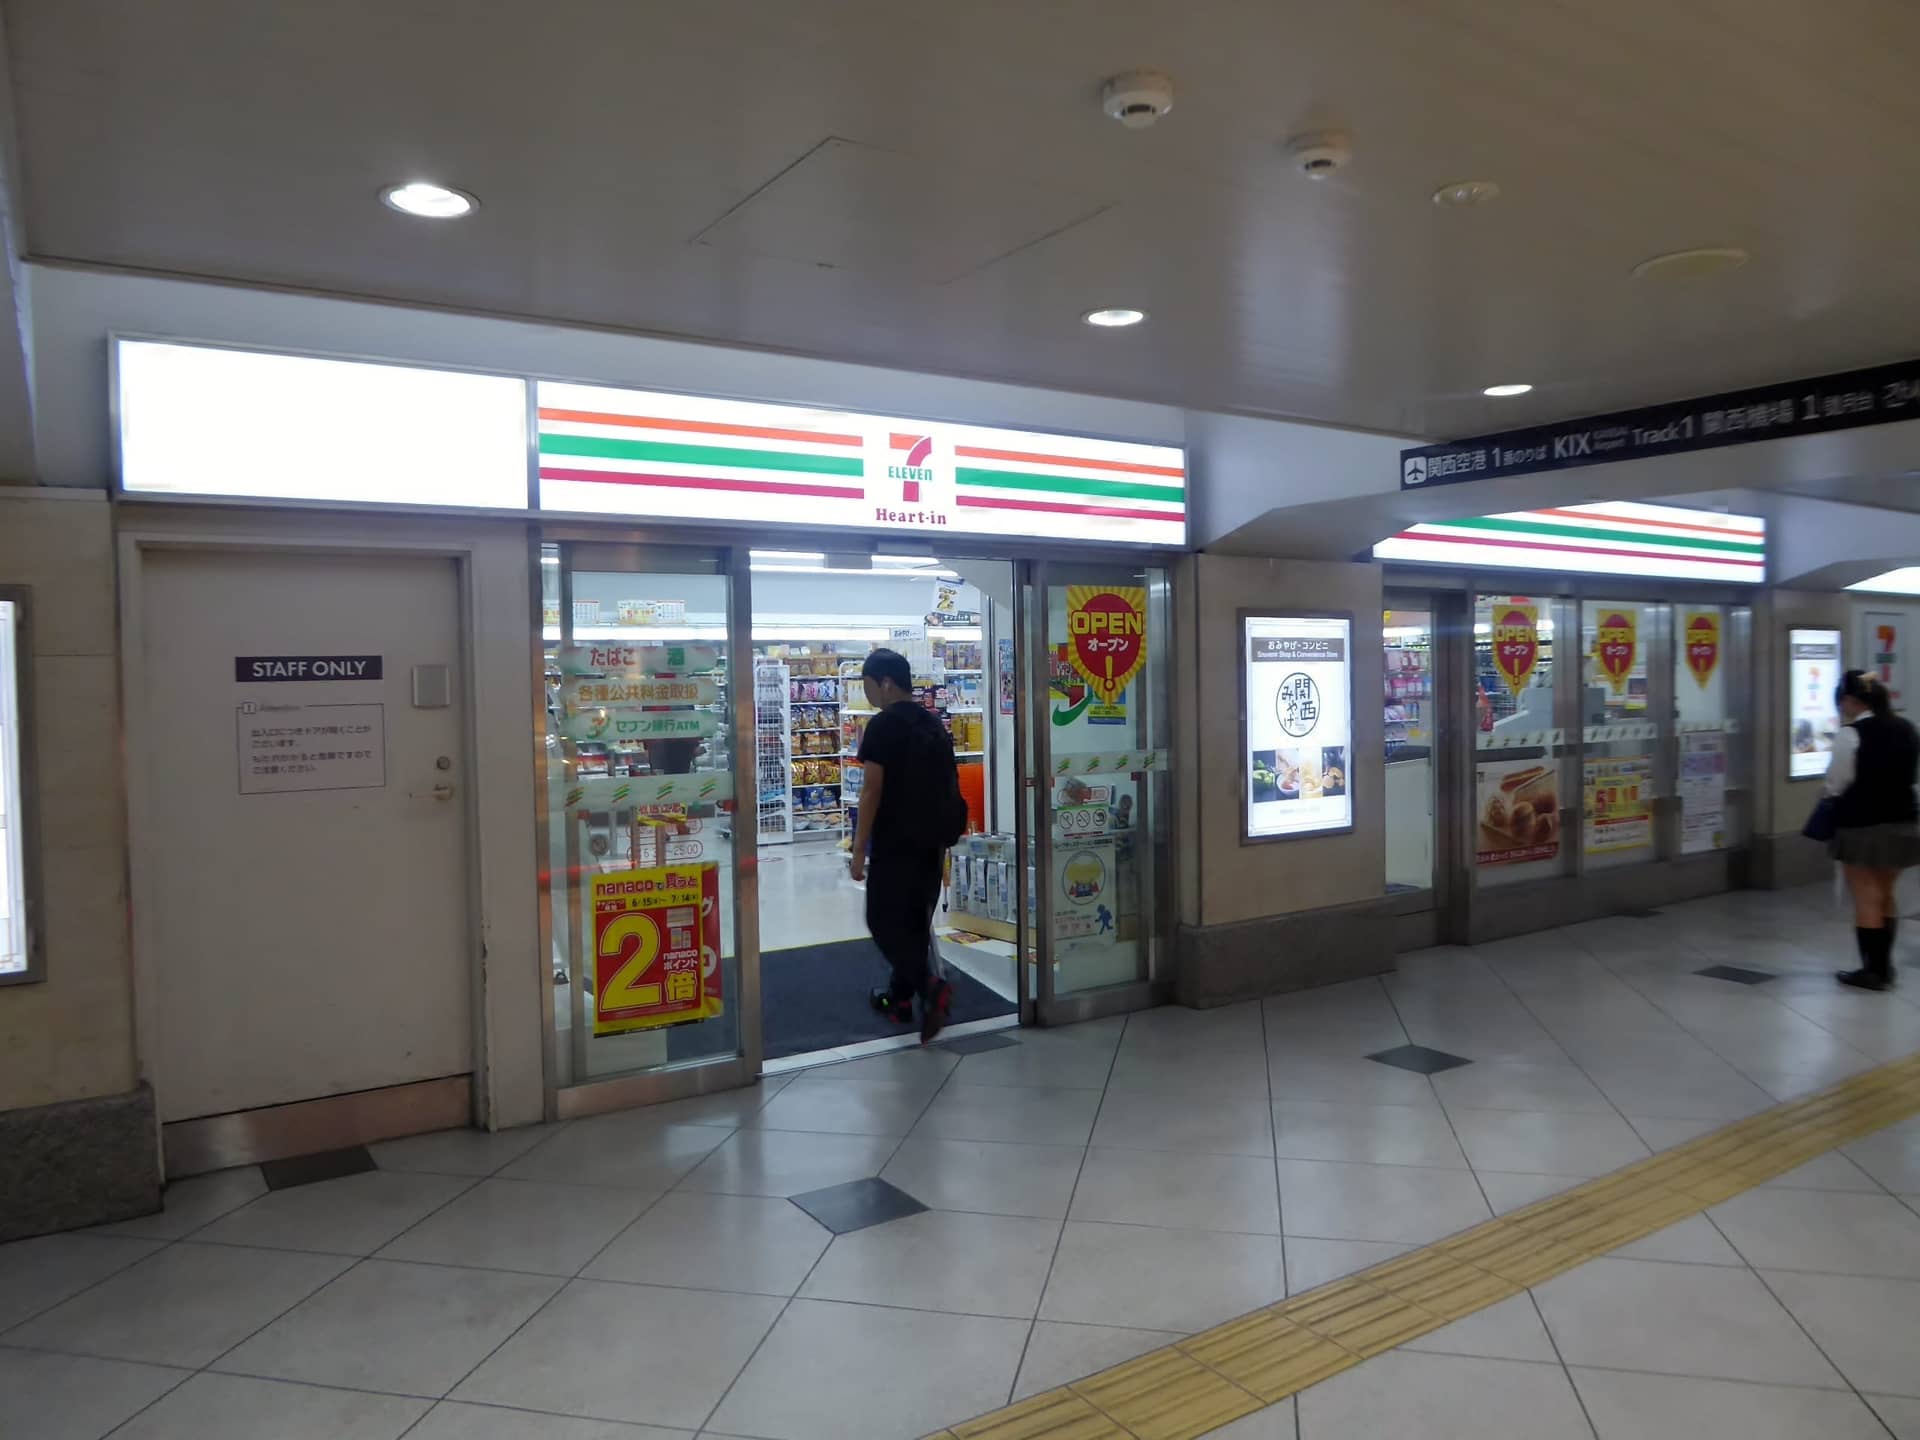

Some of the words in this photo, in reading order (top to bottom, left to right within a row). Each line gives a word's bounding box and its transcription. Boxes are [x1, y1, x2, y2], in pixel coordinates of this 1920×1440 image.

[1632, 421, 1678, 447] Track
[1553, 431, 1592, 459] KIX
[1427, 449, 1488, 479] 関西空港
[1071, 610, 1143, 636] OPEN
[1495, 624, 1536, 643] OPEN
[1087, 638, 1129, 652] オープン
[590, 648, 636, 667] たばこ
[252, 661, 308, 677] STAFF
[312, 660, 366, 676] ONLY
[599, 911, 662, 1013] 2
[662, 949, 698, 961] nanaco
[663, 958, 699, 970] ポイント
